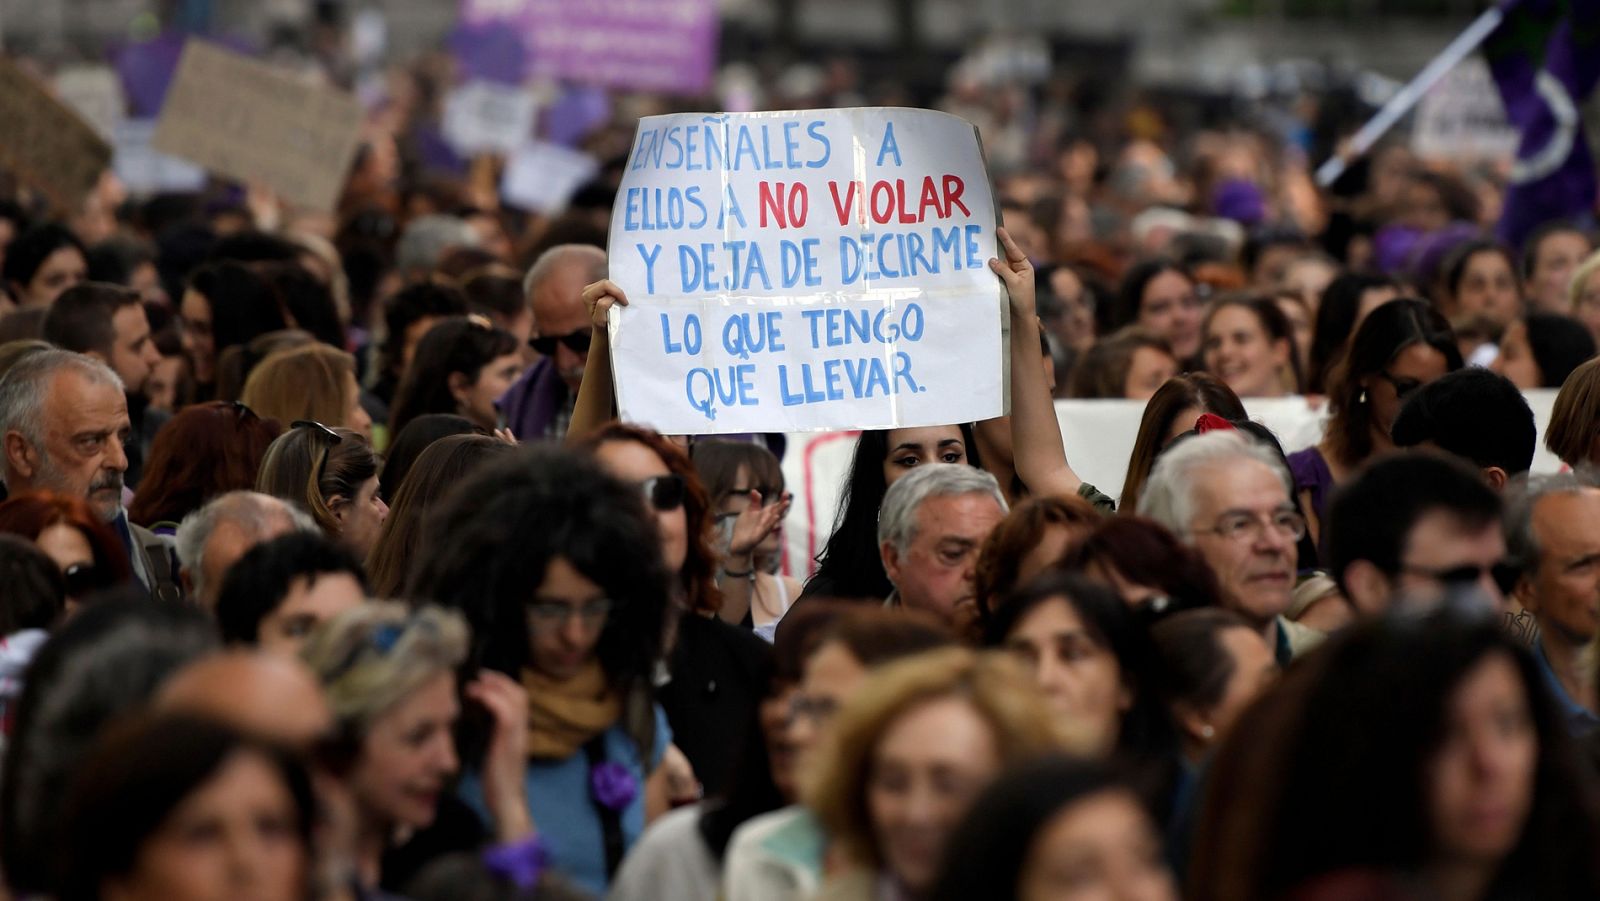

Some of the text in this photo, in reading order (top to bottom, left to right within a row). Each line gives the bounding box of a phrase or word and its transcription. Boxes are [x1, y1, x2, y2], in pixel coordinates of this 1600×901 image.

[633, 116, 902, 171] ENSEÑALES A
[624, 175, 970, 232] ELLOS A NO VIOLAR
[636, 224, 983, 295] Y DEJA DE DECIRME
[659, 303, 924, 359] LO QUE TENGO
[686, 351, 926, 420] QUE LLEVAR.
